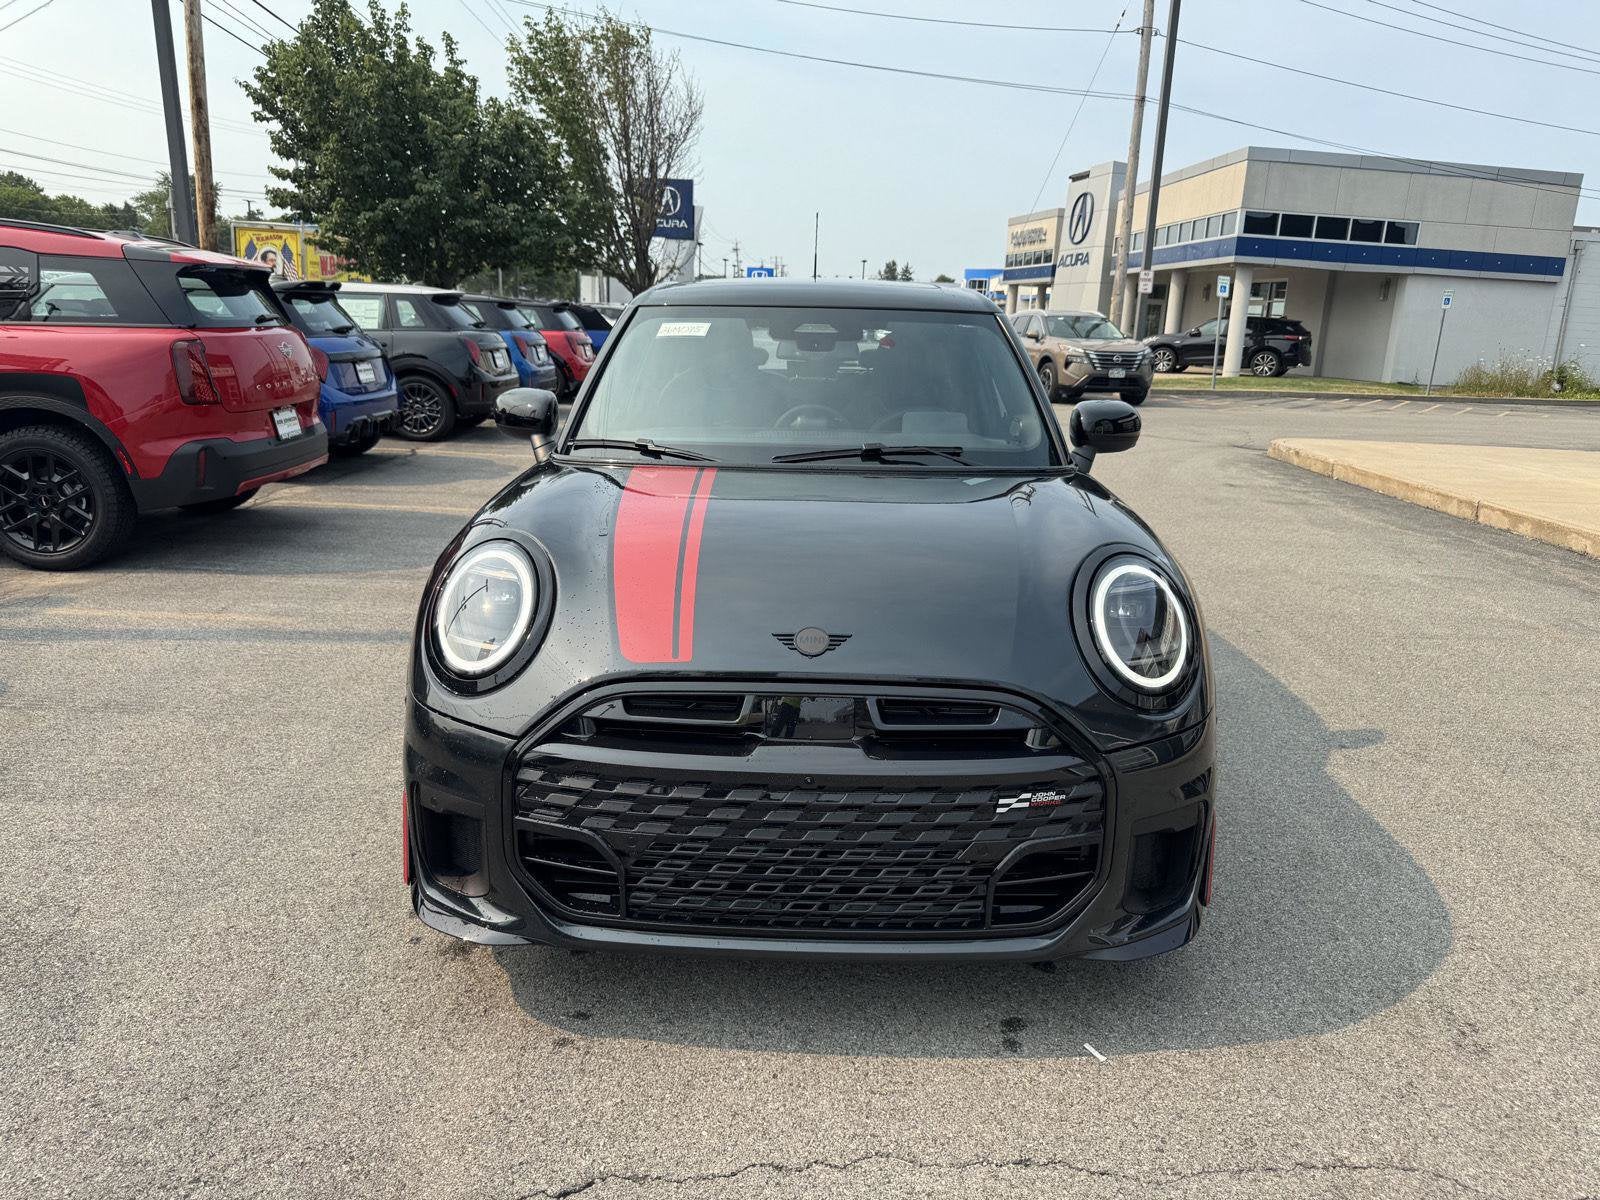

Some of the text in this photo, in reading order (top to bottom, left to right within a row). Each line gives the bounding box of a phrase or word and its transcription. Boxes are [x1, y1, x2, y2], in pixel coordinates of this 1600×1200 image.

[655, 218, 688, 229] CURA
[1057, 251, 1090, 269] ACURA
[800, 635, 826, 645] MINI
[1031, 794, 1066, 803] COOPER
[1030, 800, 1063, 808] WORKS
